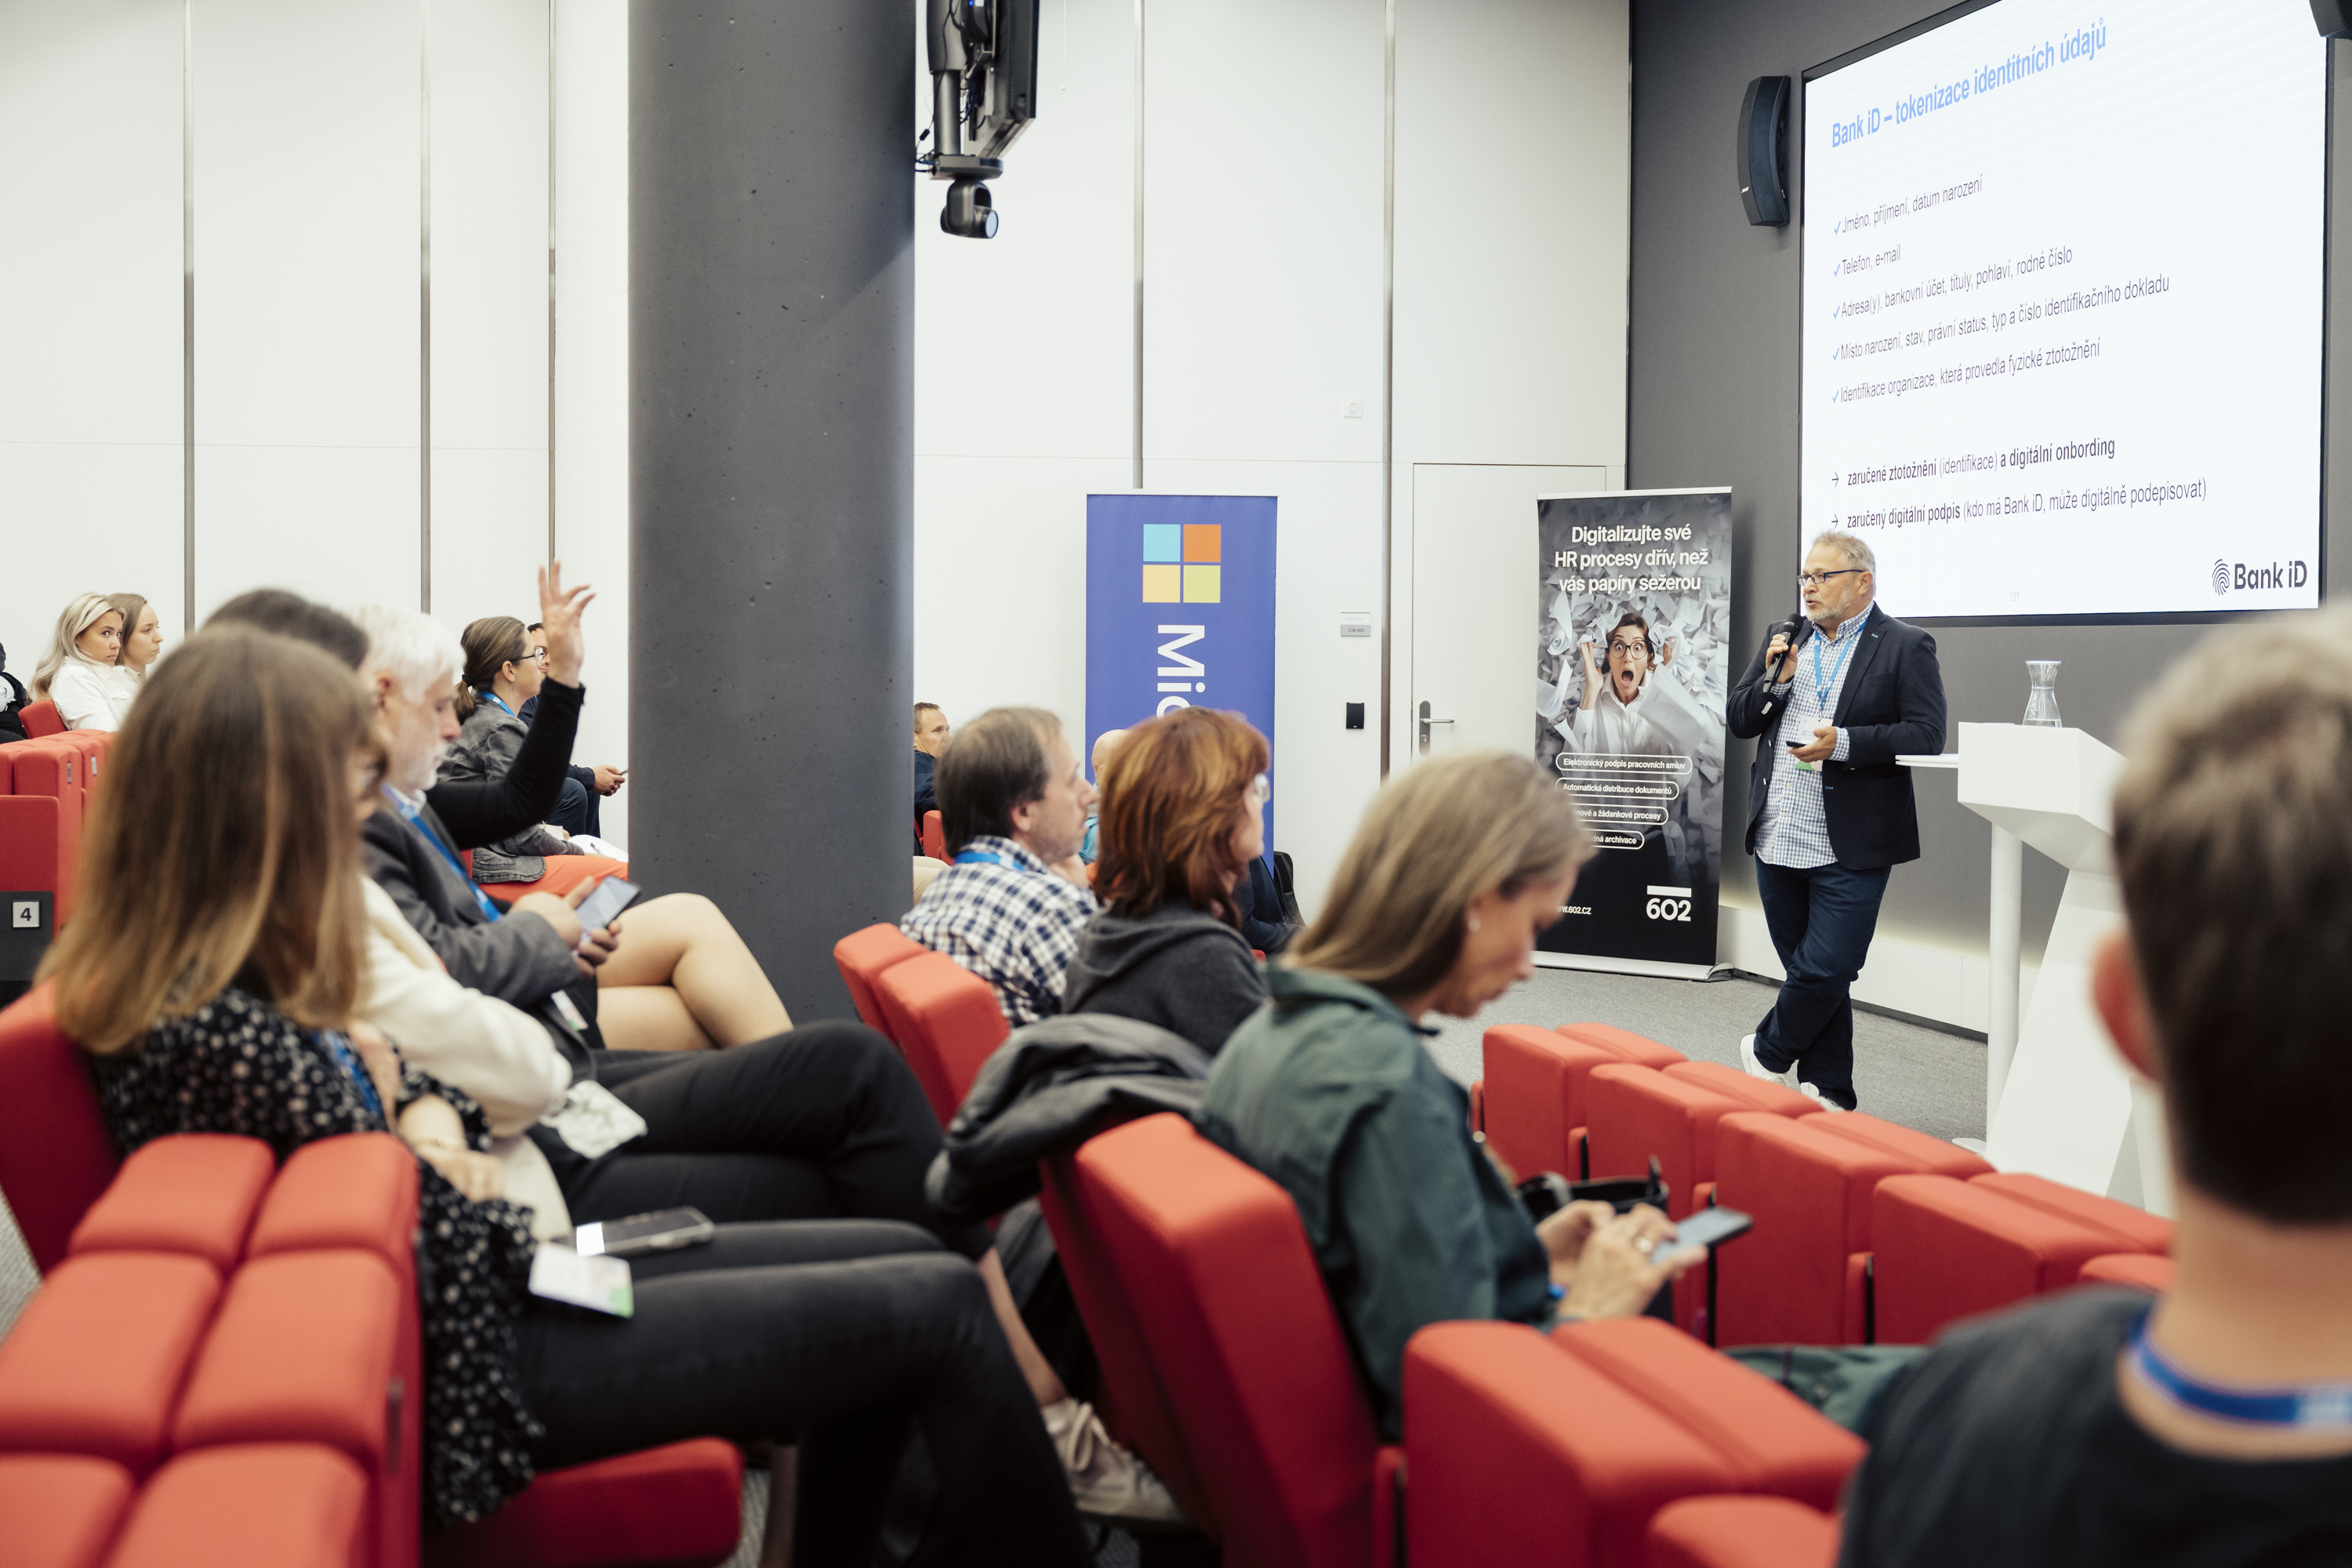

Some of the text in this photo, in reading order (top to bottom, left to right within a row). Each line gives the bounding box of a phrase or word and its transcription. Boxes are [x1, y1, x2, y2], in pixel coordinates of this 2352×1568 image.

[1832, 114, 1864, 147] Bank
[1867, 107, 1880, 135] iD
[1896, 79, 1969, 124] tokenizace
[1974, 41, 2054, 95] identitních
[2060, 17, 2106, 63] údajů
[1842, 173, 1983, 233] Jméno, příjmení, datum narození
[1842, 244, 1900, 275] Telefon, e-mail
[1841, 245, 2072, 318] Adresa(y), bankovní účet, tituly, pohlaví, rodné číslo
[1841, 273, 2169, 361] Místo narození, stav, právní status, typ a číslo identifikačního dokladu
[1841, 336, 2100, 402] Identifikace organizace, která provedla fyzické ztotožnění
[1848, 437, 2115, 485] zaručené ztotožnění (identifikace) a digitální onbording
[1847, 477, 2206, 529] zaručený digitální podpis (kdo má Bank iD, může digitálně podepisovat)
[1572, 523, 1692, 546] Digitalizujte své
[1555, 548, 1708, 570] HR procesy dřív, než
[1559, 574, 1701, 594] vás papíry sežerou
[2234, 560, 2307, 590] Bank iD
[1563, 758, 1603, 768] Elektronický
[1604, 760, 1627, 769] podpis
[1628, 760, 1664, 769] pracovních
[1563, 783, 1602, 792] Automatická
[1635, 786, 1672, 795] dokumentů
[1598, 809, 1632, 818] žádankové
[1633, 812, 1661, 821] procesy
[1605, 835, 1637, 844] archivace
[20, 907, 32, 921] 4
[1646, 898, 1691, 922] 602
